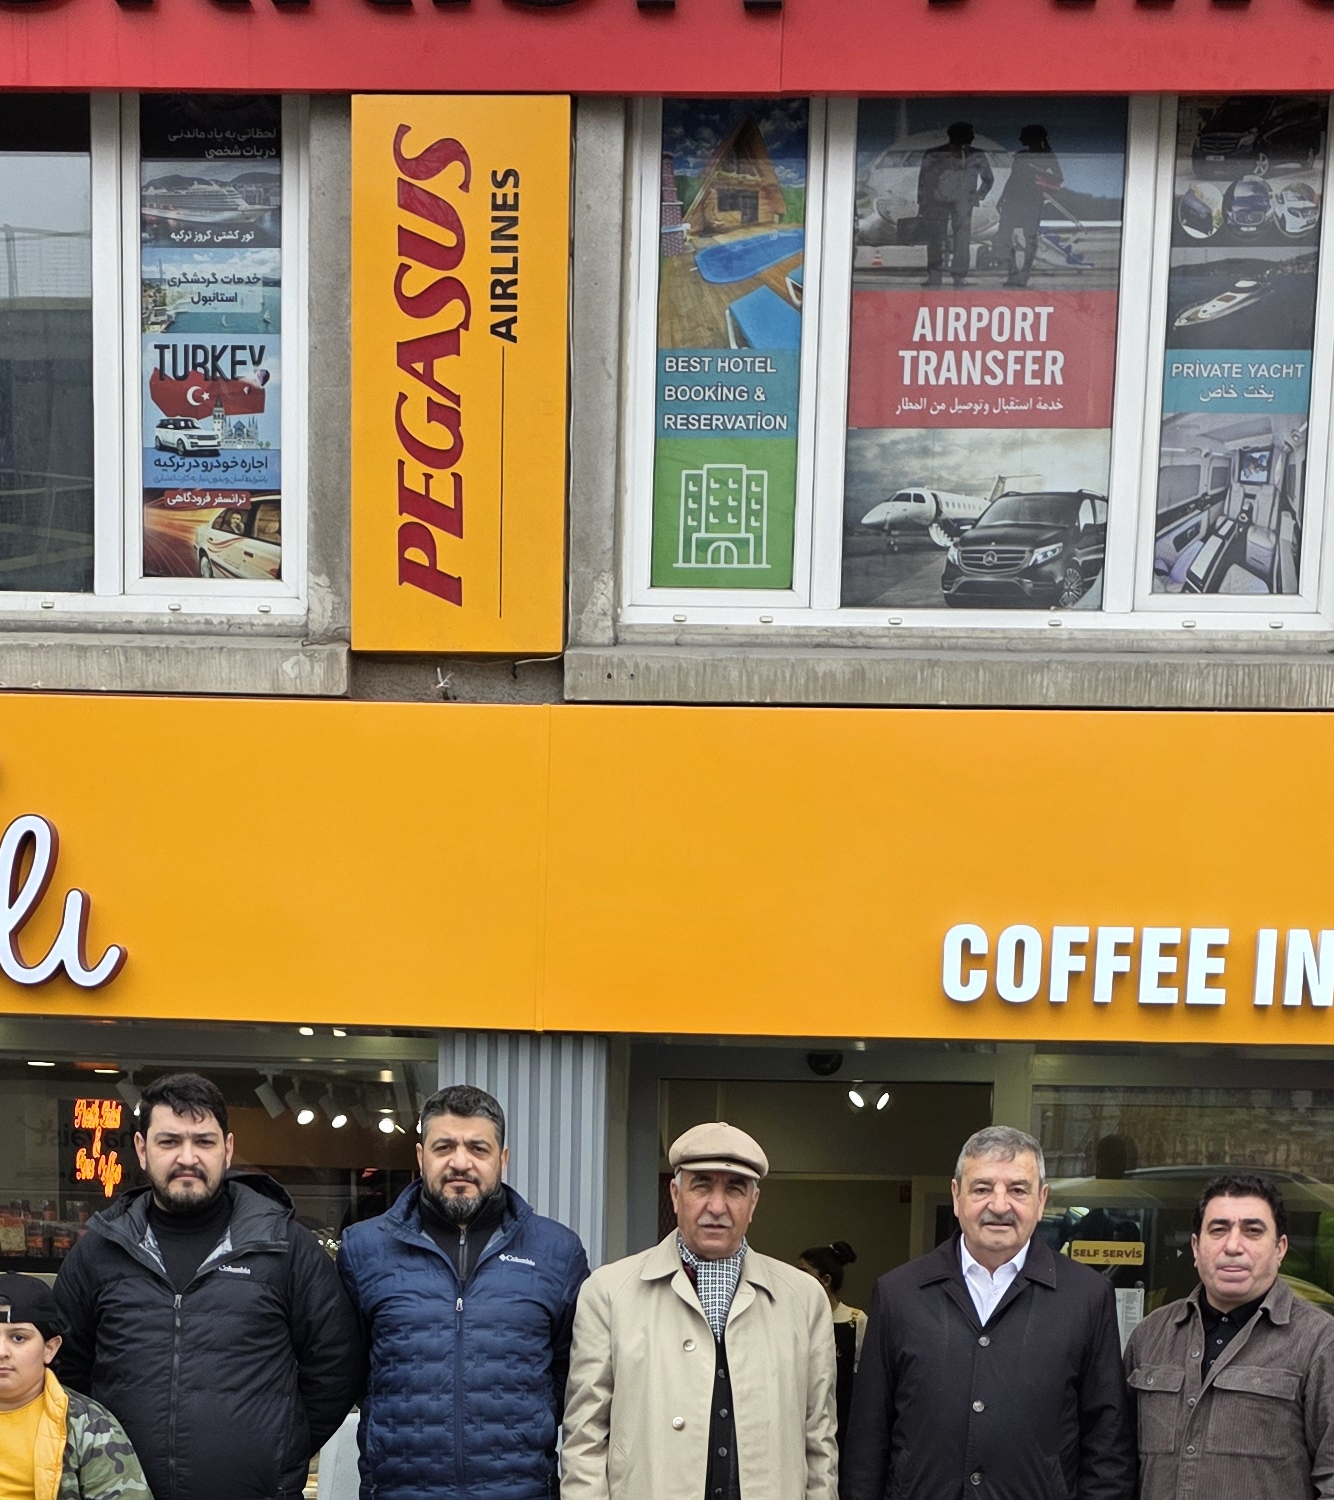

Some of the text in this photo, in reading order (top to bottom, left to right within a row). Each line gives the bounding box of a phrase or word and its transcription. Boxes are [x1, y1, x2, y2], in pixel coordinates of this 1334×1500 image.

[489, 167, 521, 344] AIRLINES
[221, 272, 262, 286] خدمات
[191, 291, 238, 306] استانبول
[912, 306, 1054, 343] AIRPORT
[153, 343, 267, 382] TURKEY
[392, 123, 473, 608] PEGASUS
[665, 356, 777, 374] BEST HOTEL
[898, 349, 1066, 387] TRANSFER
[1247, 363, 1305, 378] YACHT
[754, 385, 767, 402] &
[1199, 384, 1238, 402] خاص
[895, 397, 927, 416] المطار
[929, 403, 947, 415] من
[992, 397, 1033, 414] استقبال
[1036, 397, 1064, 411] خدمة
[940, 923, 1230, 1006] COFFEE
[1073, 1247, 1143, 1259] SELF SERVİS
